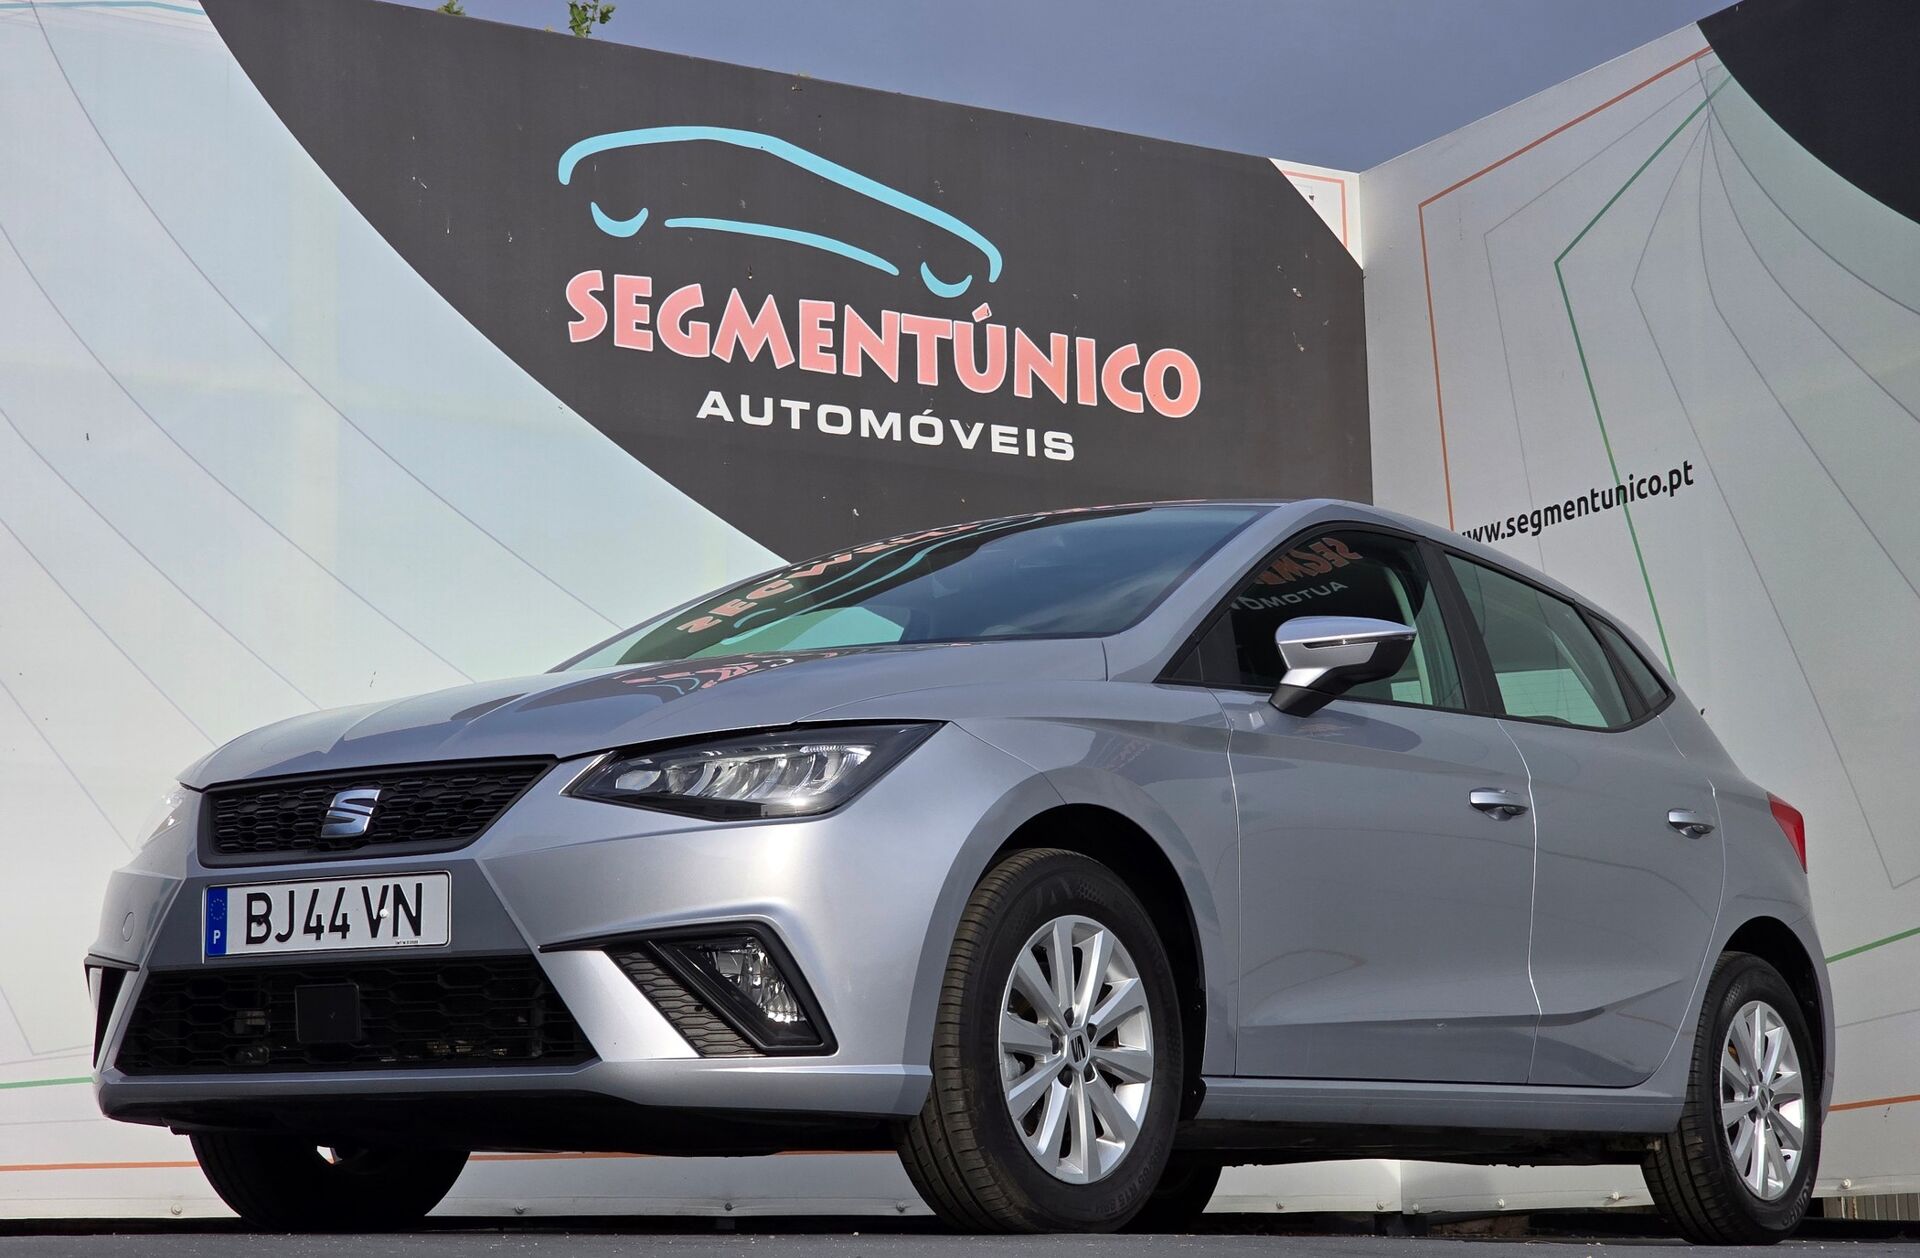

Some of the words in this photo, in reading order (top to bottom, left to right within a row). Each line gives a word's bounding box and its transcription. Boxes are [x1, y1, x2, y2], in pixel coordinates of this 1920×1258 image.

[565, 269, 1201, 418] SEGMENTÚNICO
[696, 390, 1075, 461] AUTOMÓVEIS
[1461, 460, 1694, 543] ww.segmentunico.pt
[212, 929, 221, 944] P
